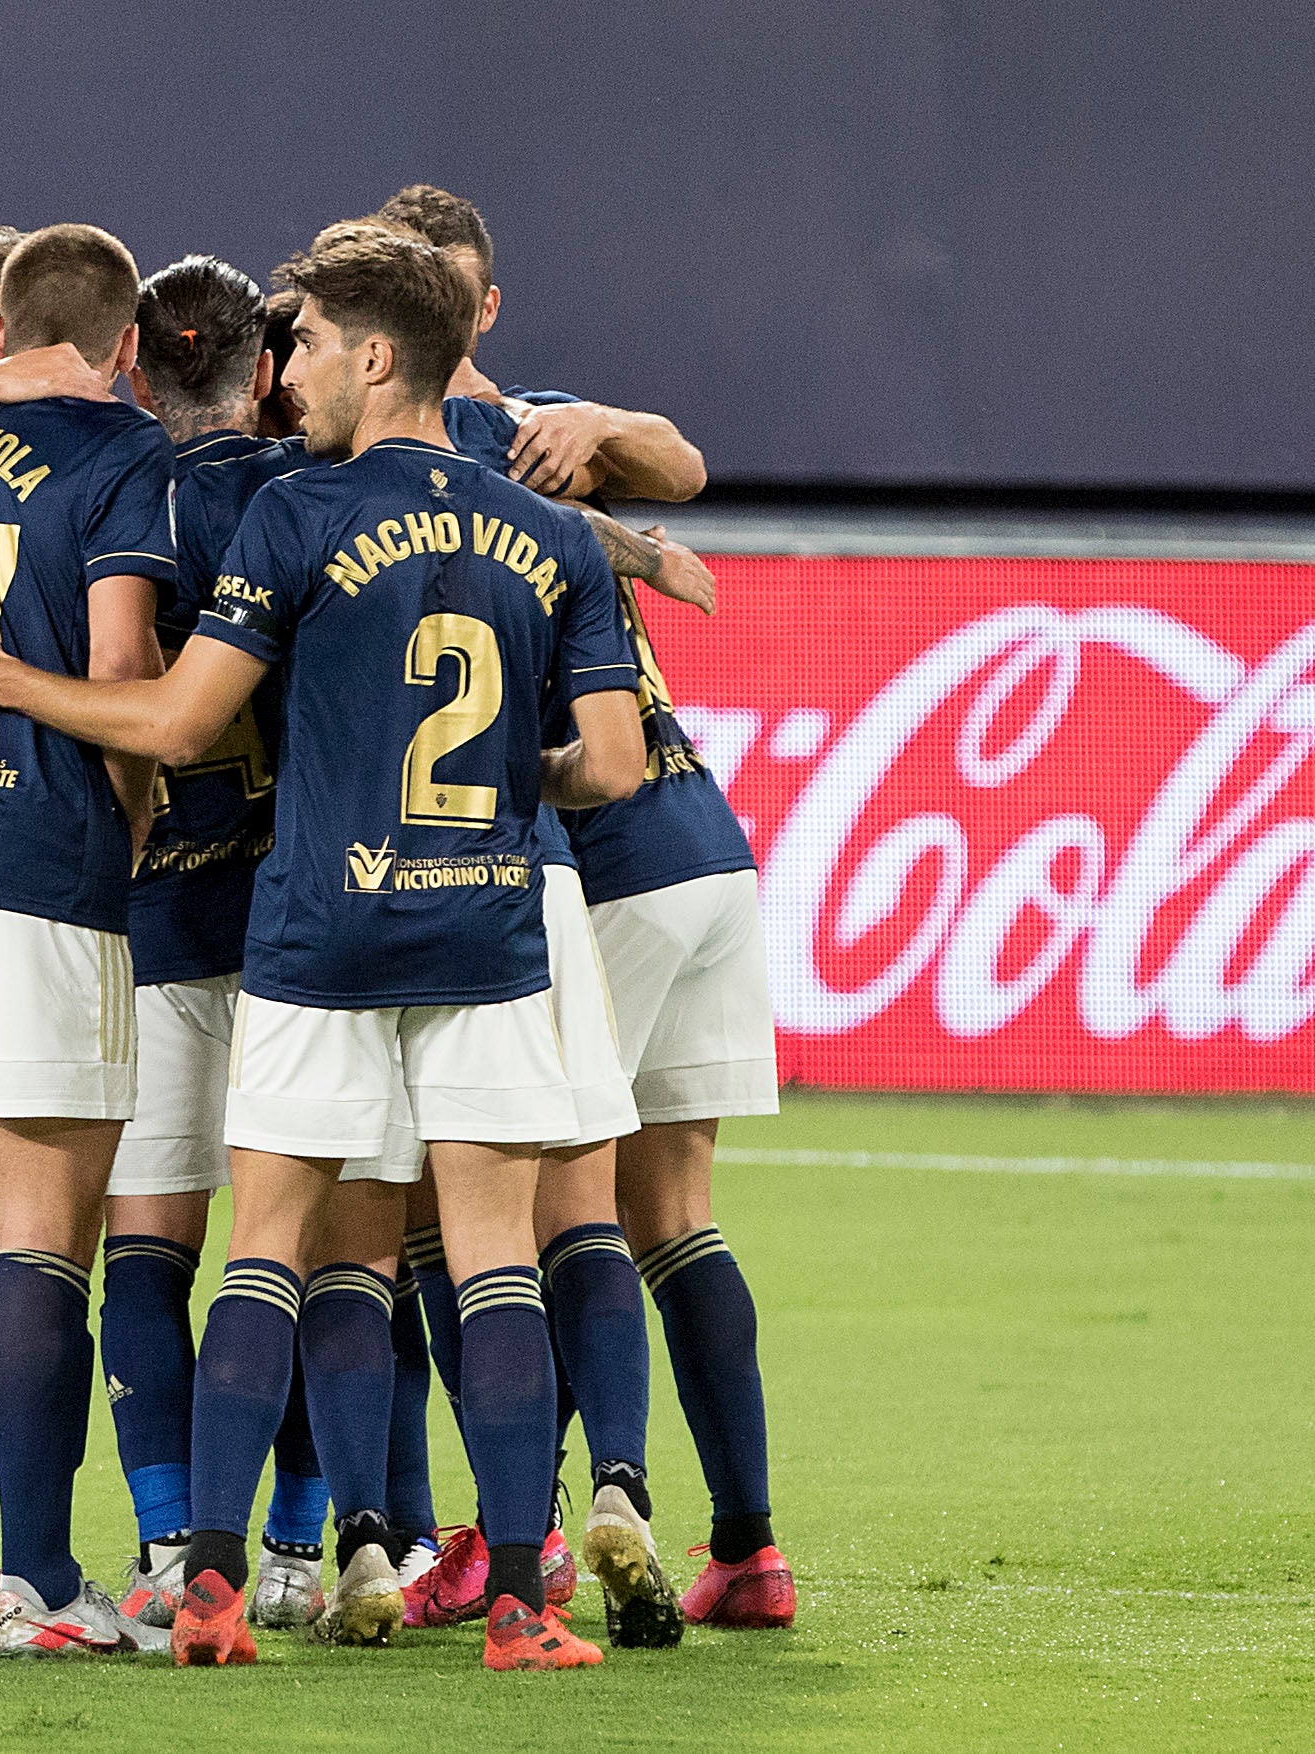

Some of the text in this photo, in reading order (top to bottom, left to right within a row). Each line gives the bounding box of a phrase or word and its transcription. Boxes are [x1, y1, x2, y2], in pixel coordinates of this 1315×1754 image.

[324, 511, 461, 598] NACHO
[401, 613, 503, 830] 2
[394, 864, 489, 891] VICTORINO
